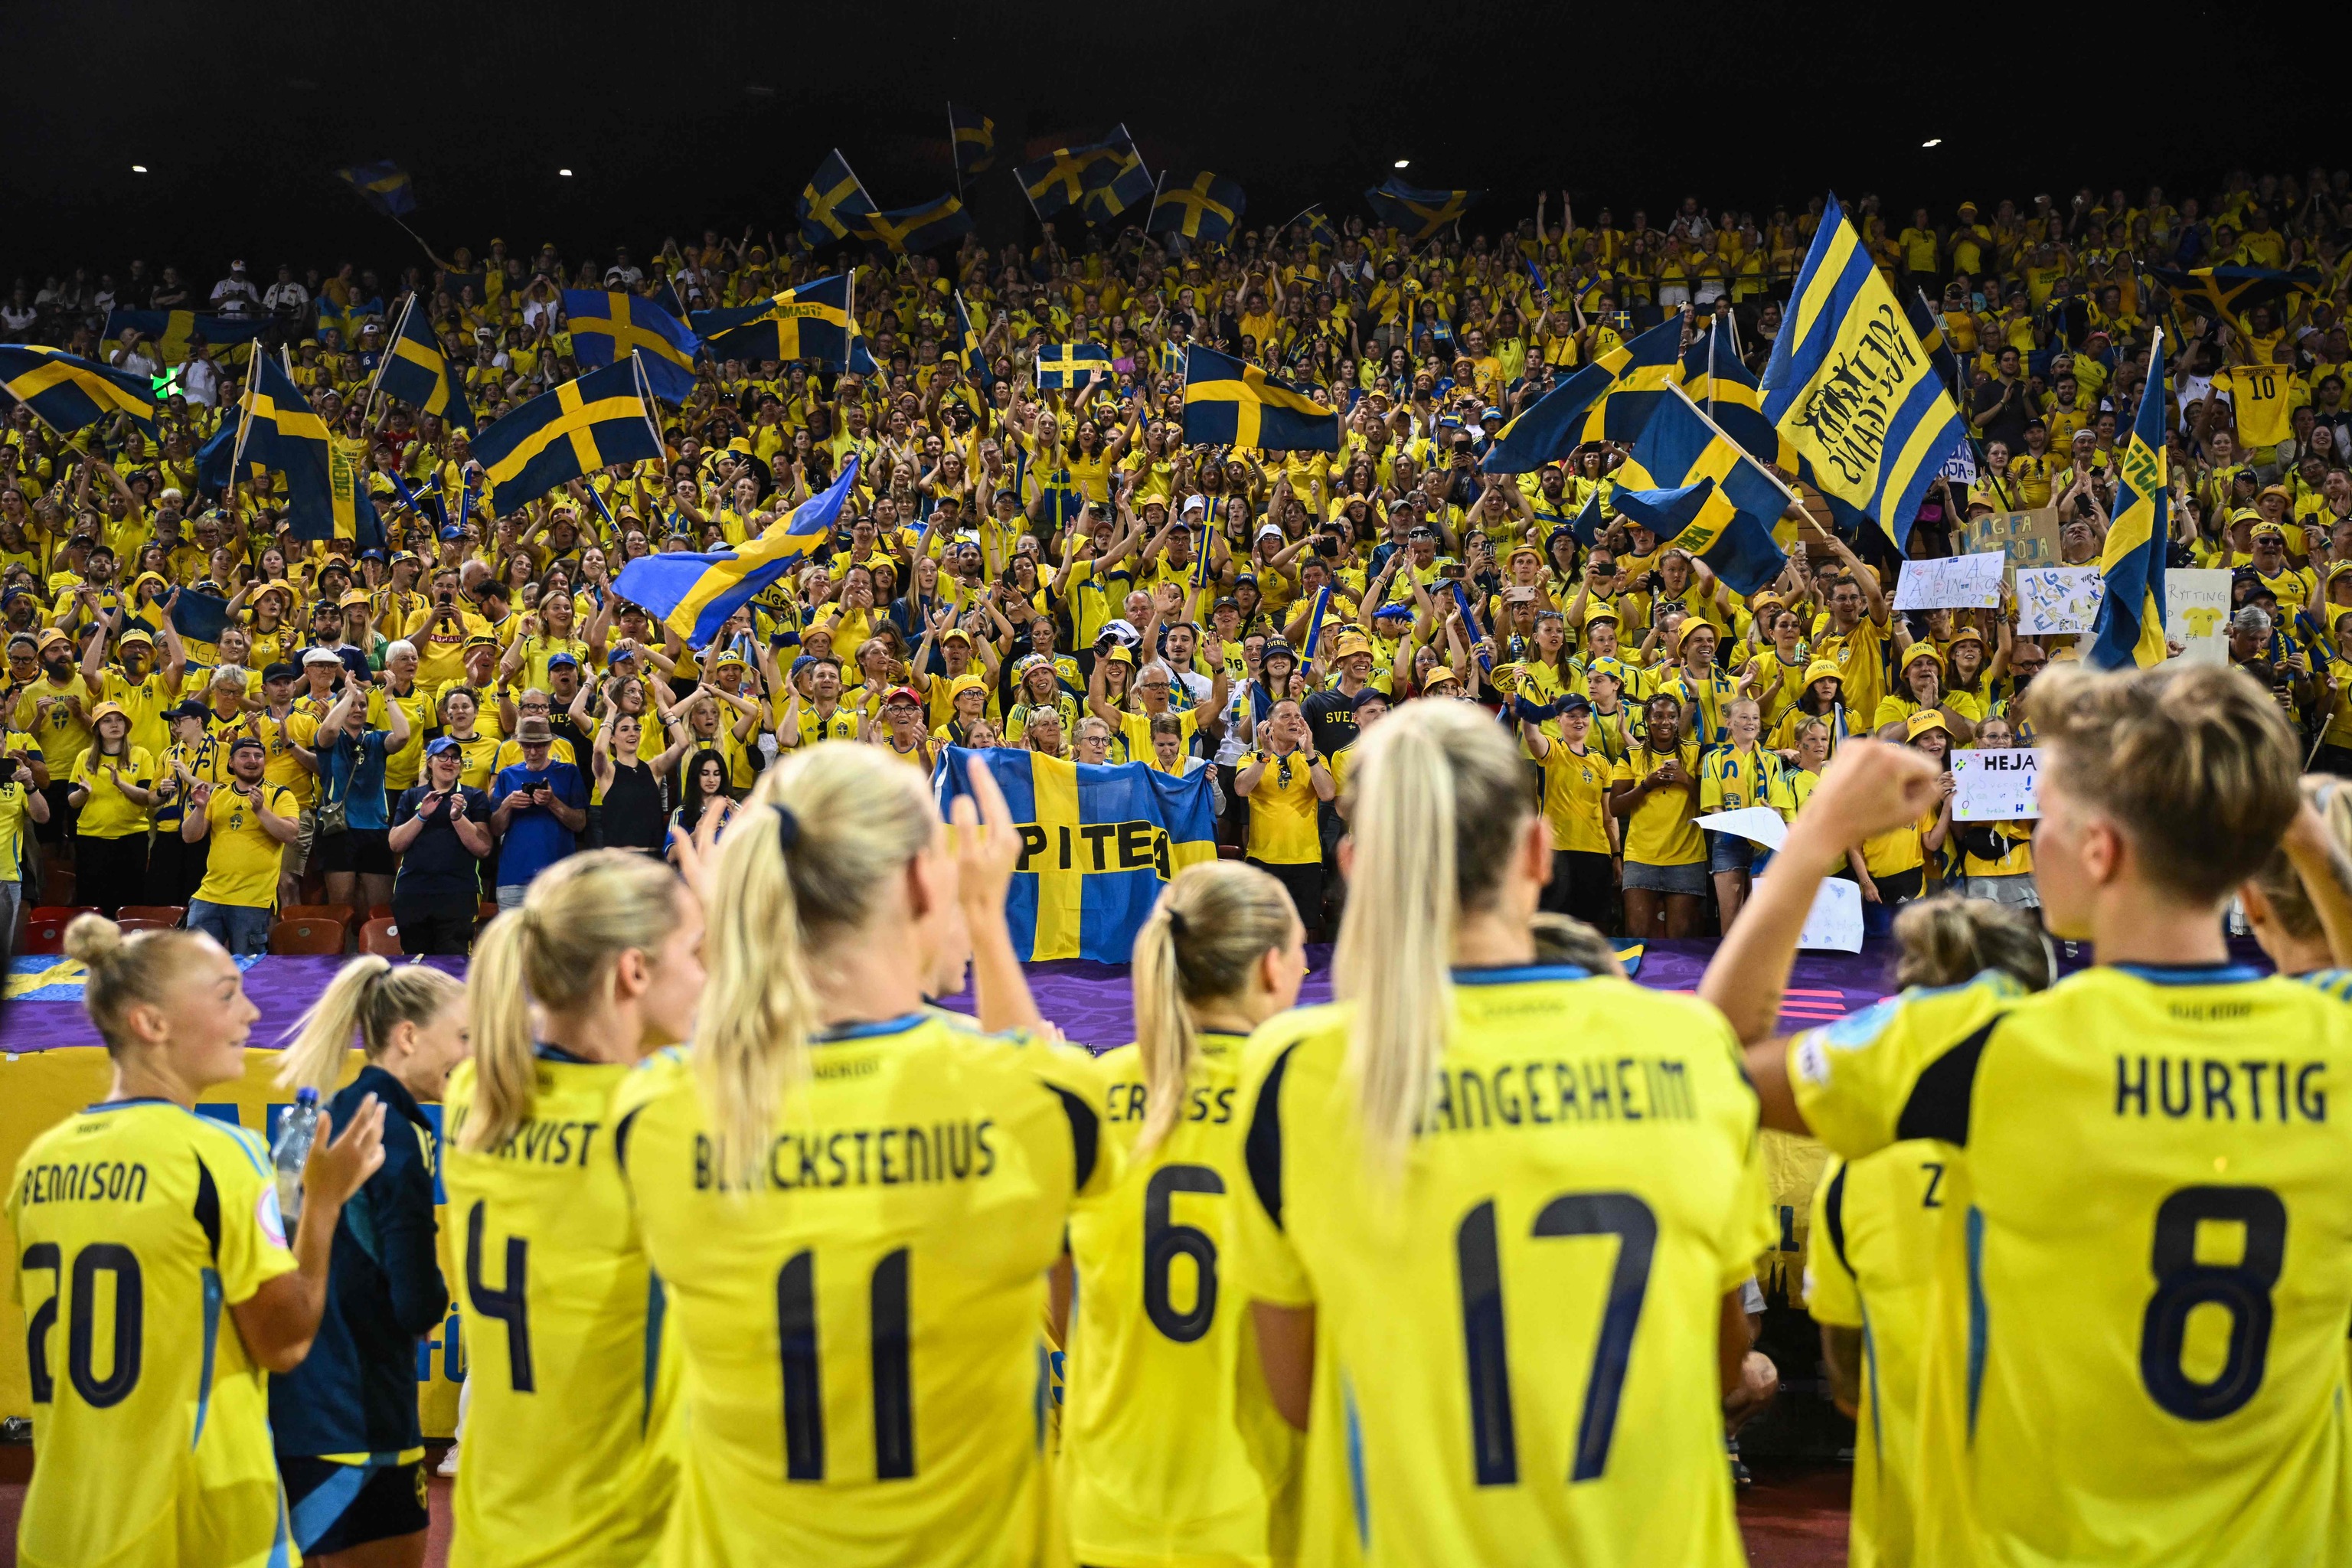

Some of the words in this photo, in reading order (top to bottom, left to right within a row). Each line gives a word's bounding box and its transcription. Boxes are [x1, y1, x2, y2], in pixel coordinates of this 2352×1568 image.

[1603, 333, 1615, 343] 17
[363, 355, 371, 366] 16
[2249, 376, 2276, 400] 10
[1972, 518, 2005, 543] JAG
[1984, 537, 2050, 560] TRÖJA
[2025, 571, 2060, 597] JAG
[2167, 583, 2226, 603] RYTTING
[2034, 606, 2063, 632] ER
[430, 635, 462, 643] AUHAU
[1267, 642, 1289, 650] SVERIGE
[2184, 629, 2198, 642] FÅ
[1984, 753, 2037, 771] HEJA
[2115, 1054, 2327, 1122] HURTIG
[22, 1161, 147, 1205] BENNISON
[1143, 1165, 1227, 1344] 6
[466, 1198, 537, 1393] 4
[2140, 1184, 2288, 1422] 8
[22, 1242, 142, 1409] 20
[1456, 1192, 1658, 1486] 17
[776, 1246, 916, 1482] 11
